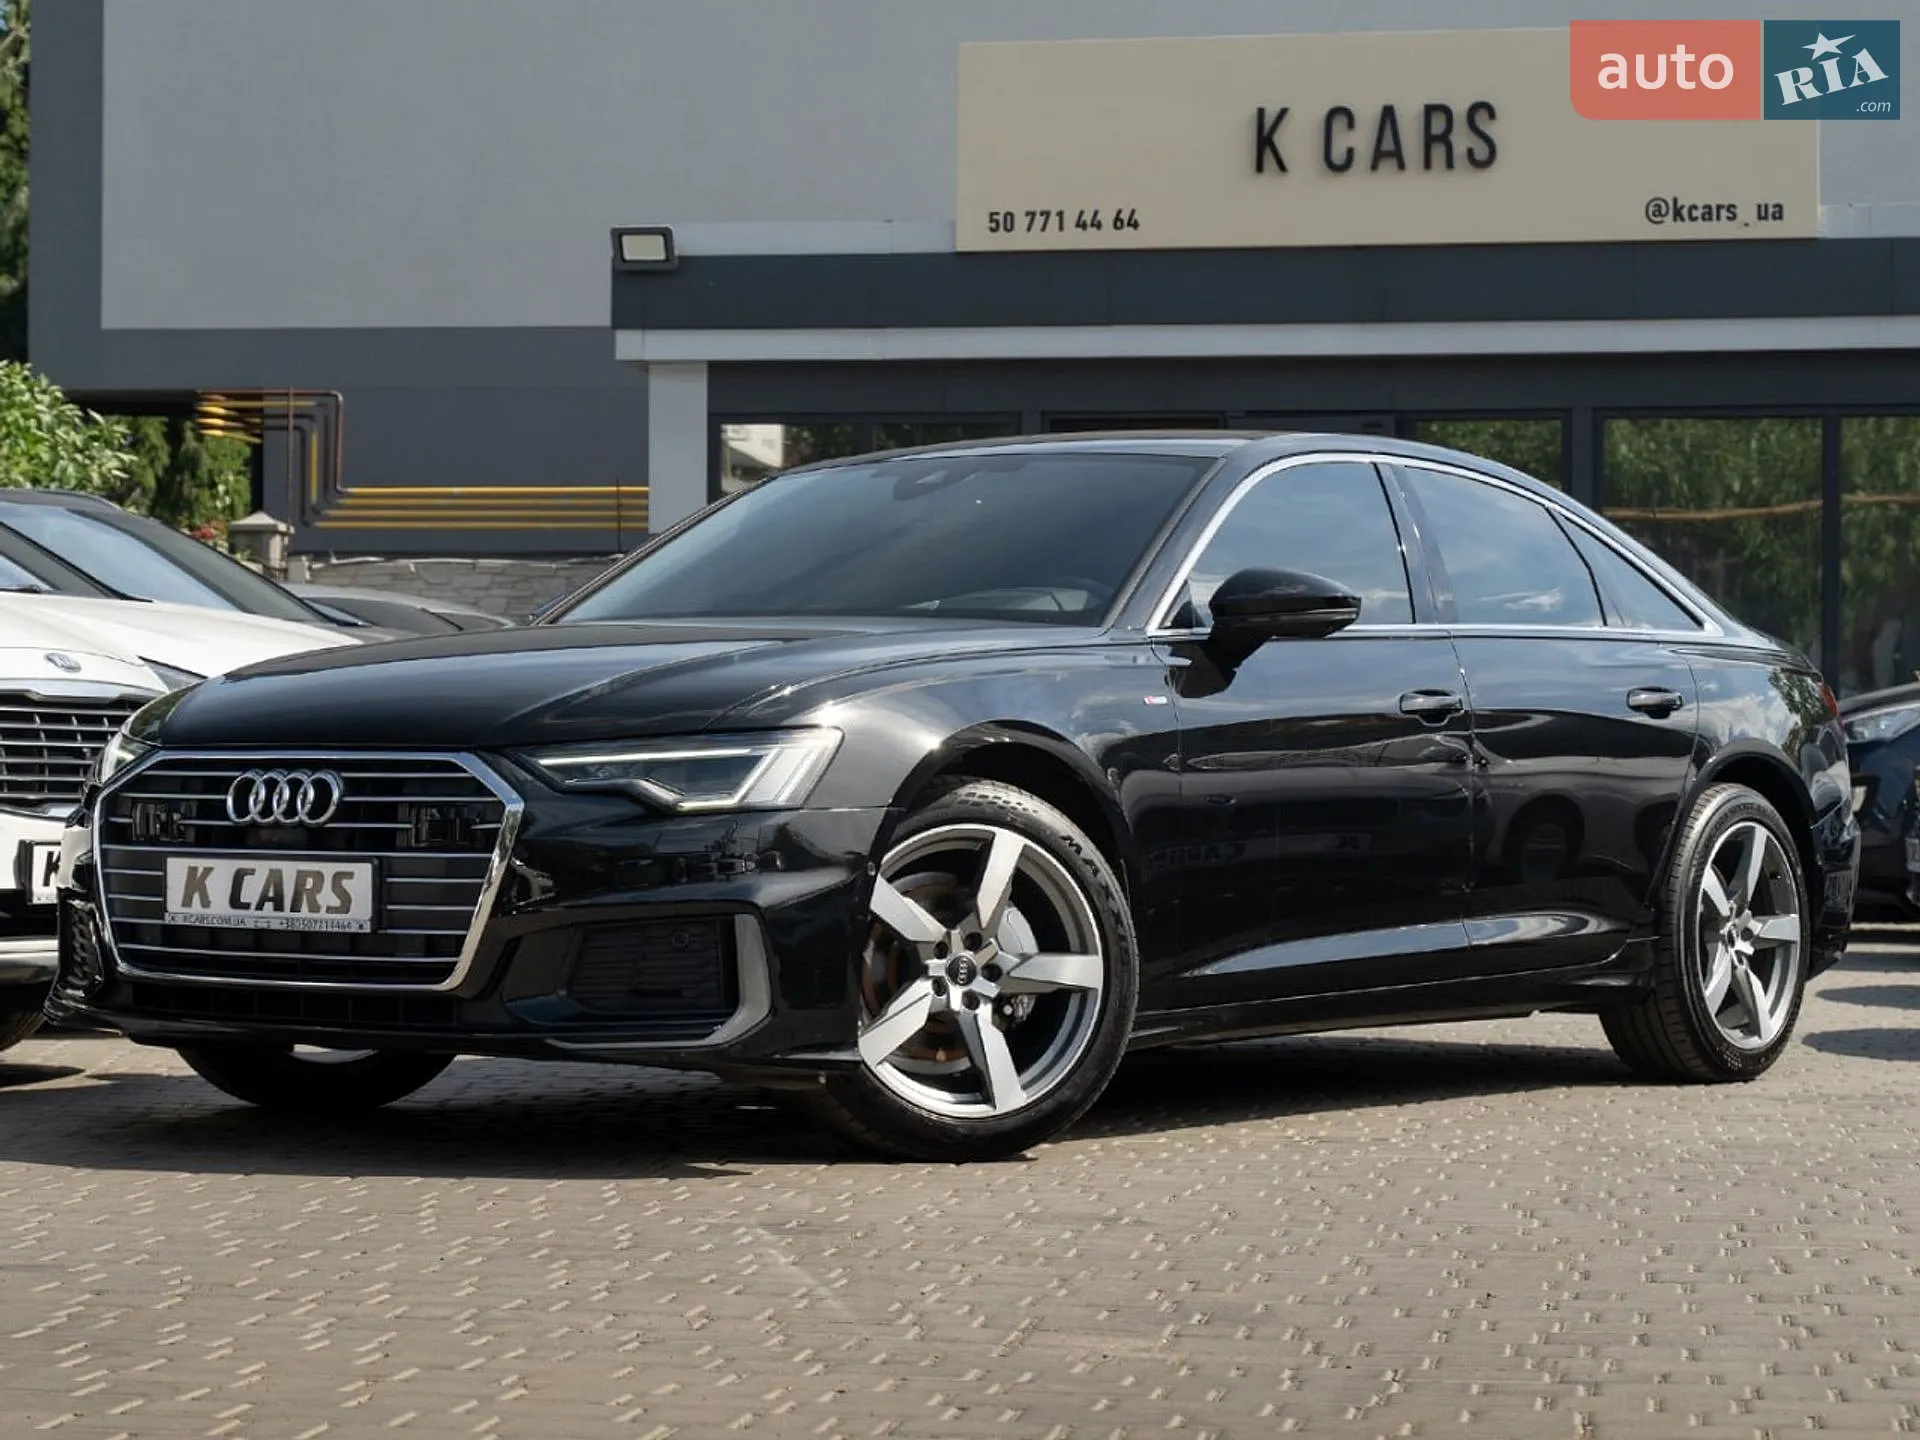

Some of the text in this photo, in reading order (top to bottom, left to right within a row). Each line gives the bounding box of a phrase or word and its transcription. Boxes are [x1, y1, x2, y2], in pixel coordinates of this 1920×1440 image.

[1255, 101, 1498, 174] K CARS
[988, 207, 1141, 233] 50 771 44 64
[181, 866, 355, 915] K CARS
